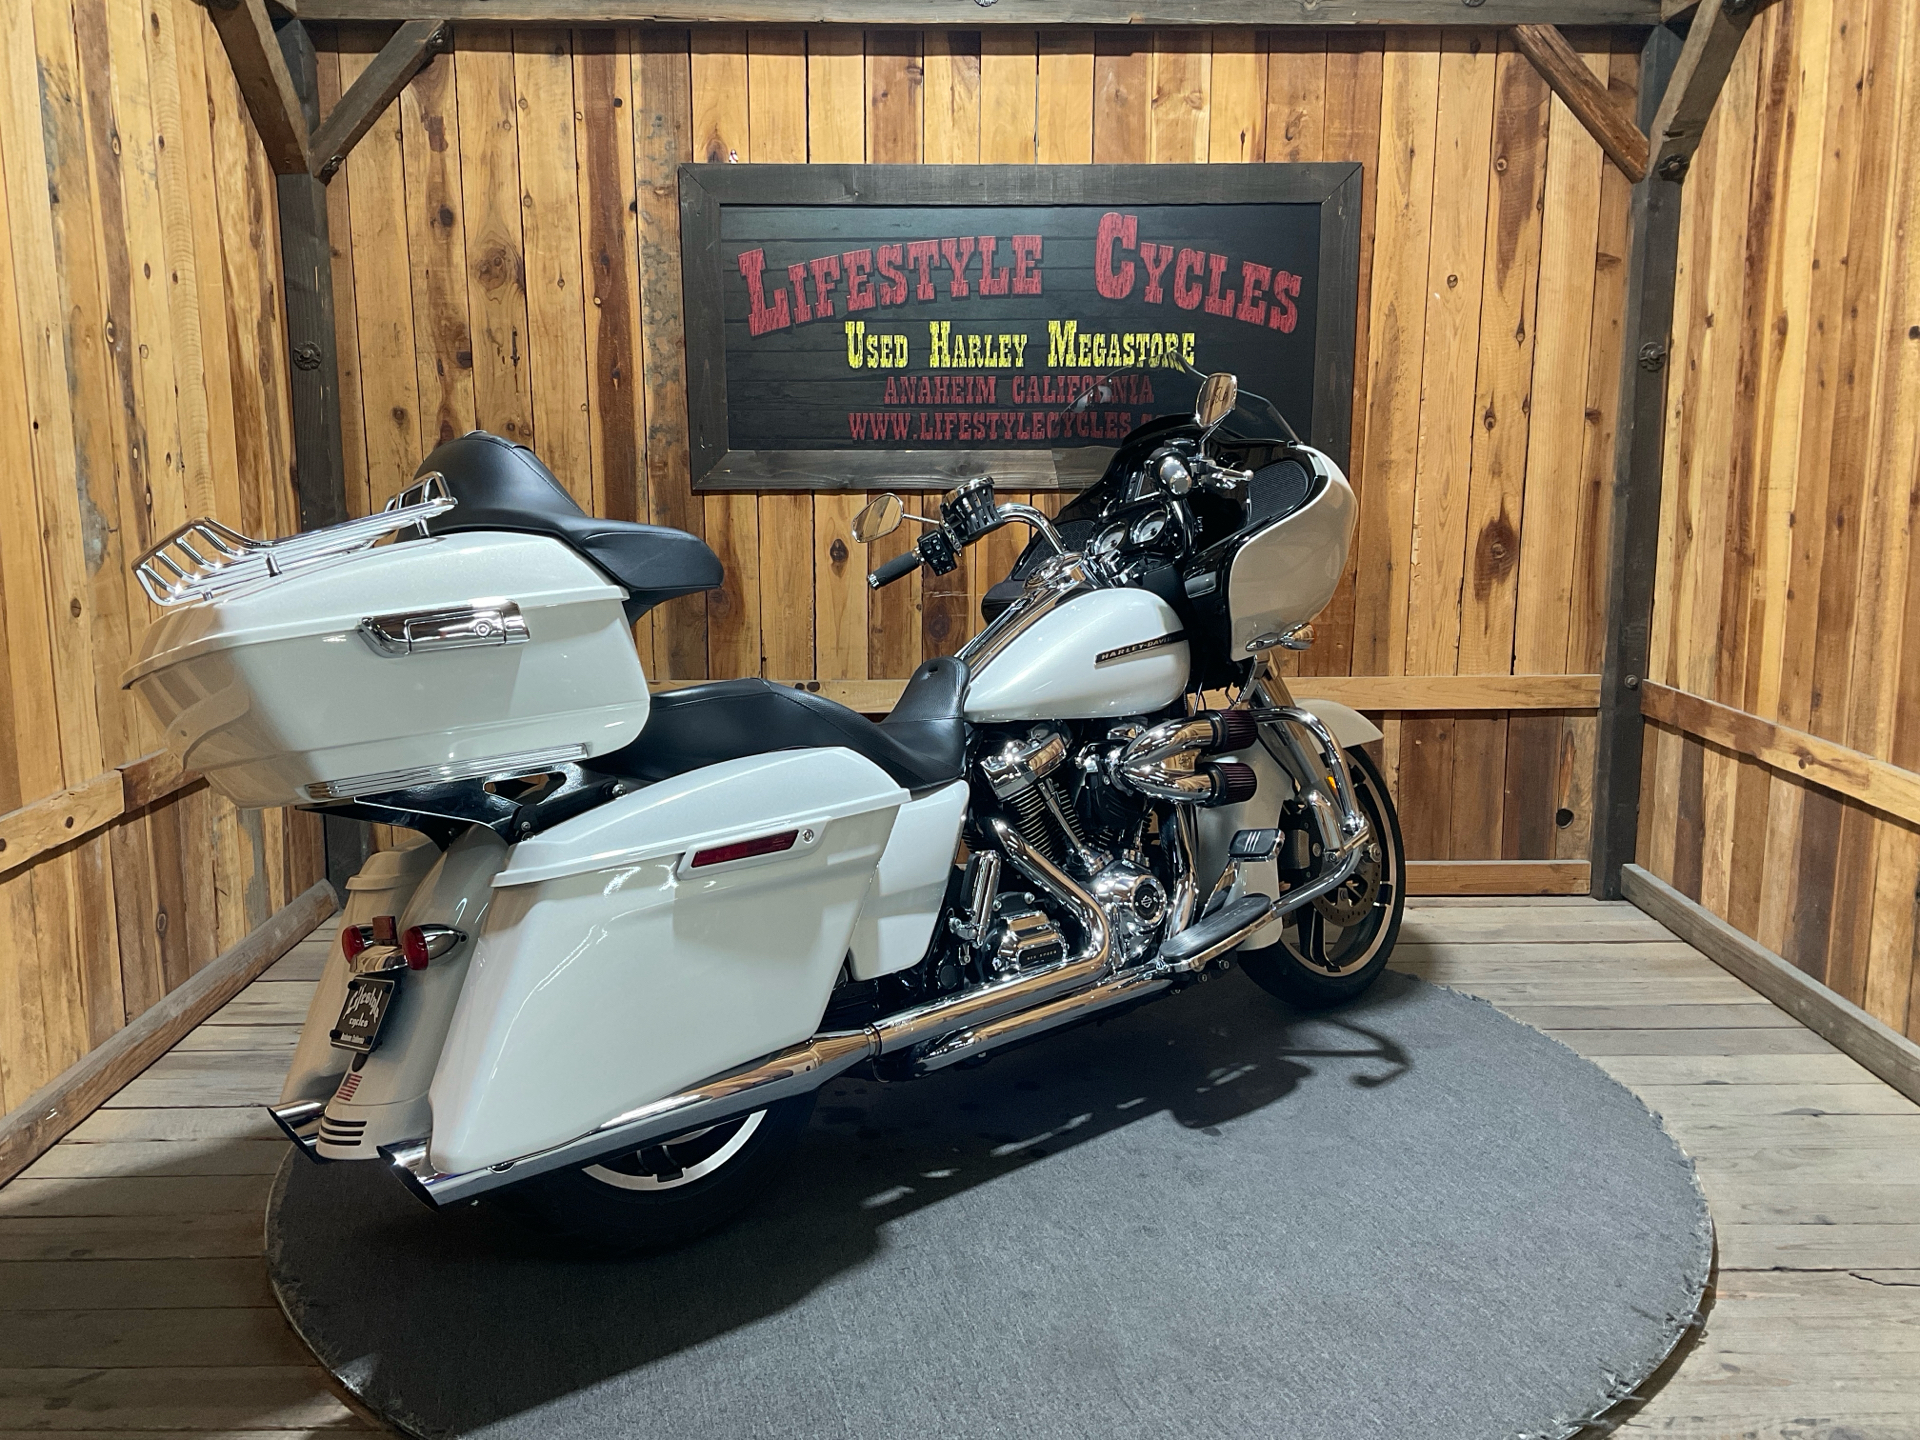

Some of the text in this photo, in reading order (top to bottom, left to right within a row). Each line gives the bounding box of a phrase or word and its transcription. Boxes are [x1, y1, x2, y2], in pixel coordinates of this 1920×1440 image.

[738, 211, 1303, 337] LIFESTYLE CYCLES
[845, 320, 1196, 371] USED HARLEY MEGASTORE
[884, 375, 997, 404] ANAHEIM
